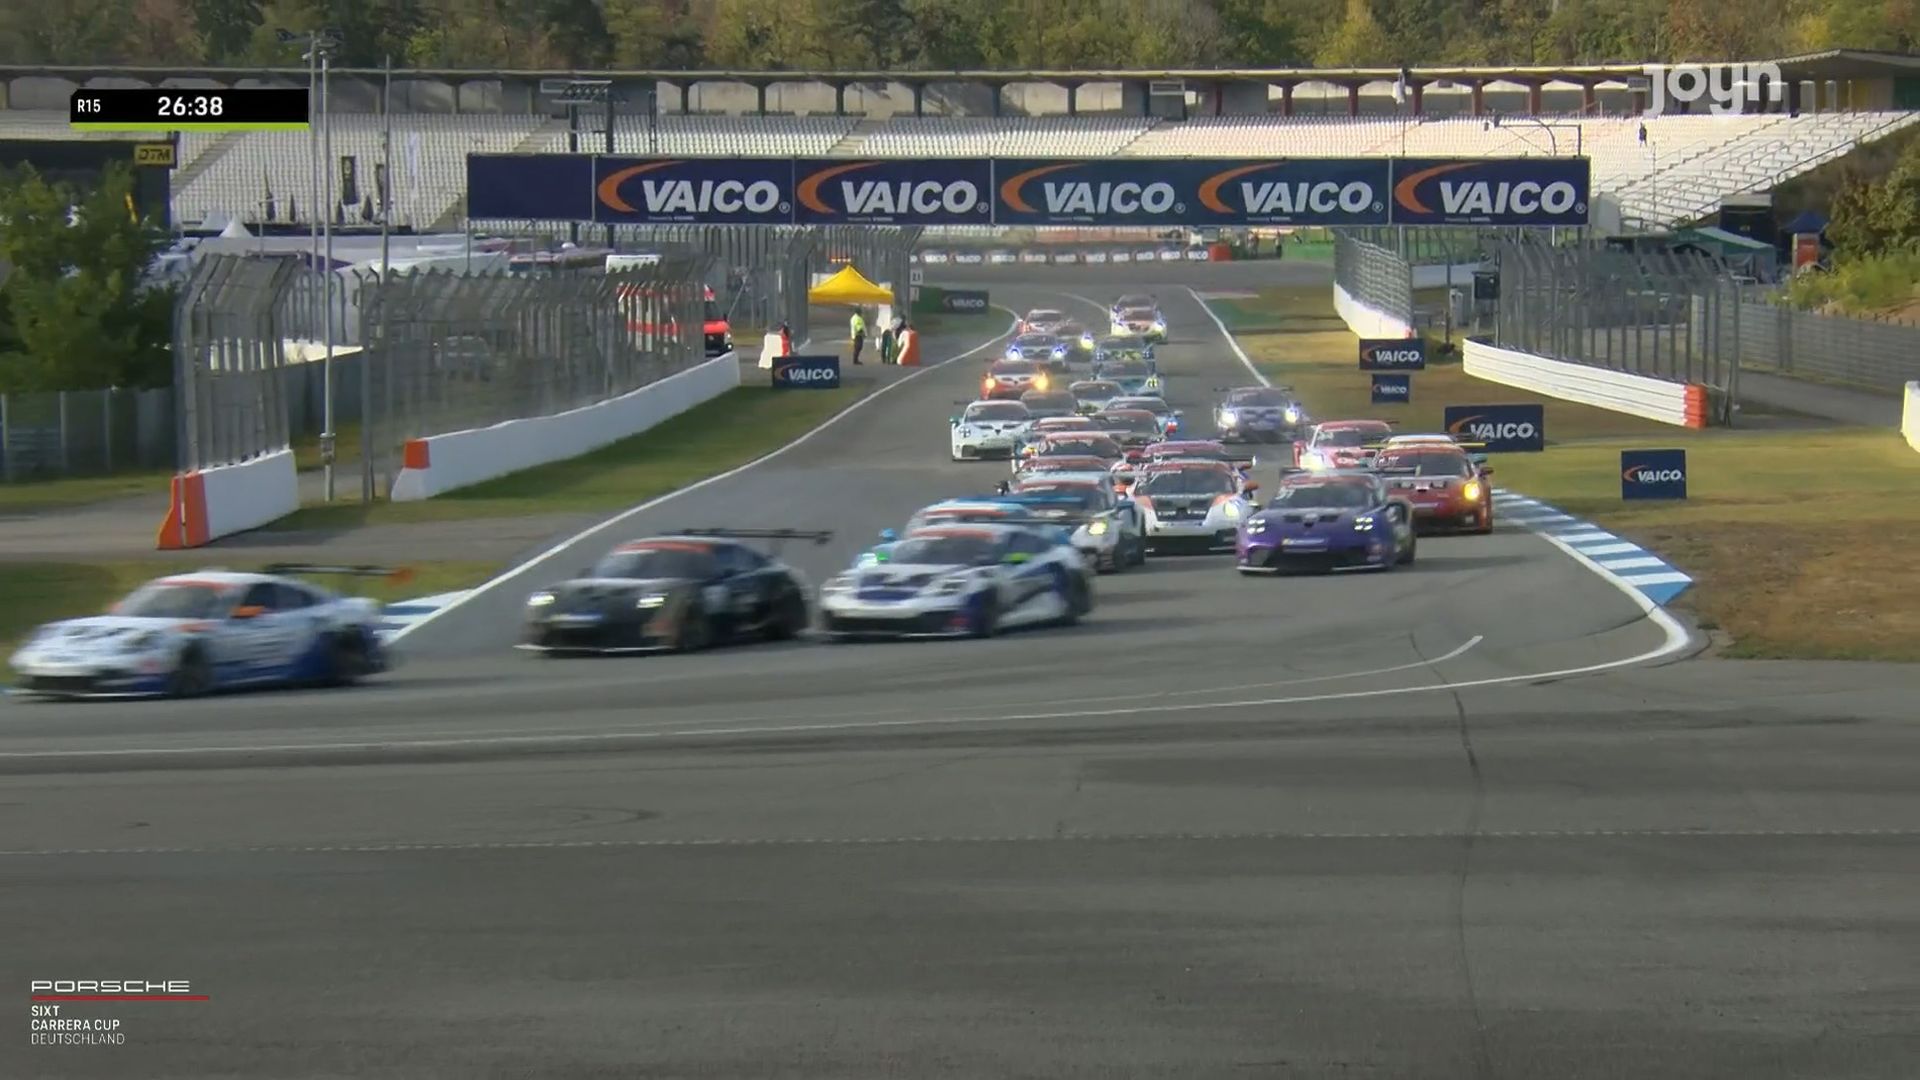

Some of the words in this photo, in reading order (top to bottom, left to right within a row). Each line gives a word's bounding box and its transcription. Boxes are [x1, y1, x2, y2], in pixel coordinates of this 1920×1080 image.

[138, 148, 171, 161] DTM
[1375, 350, 1419, 362] VAICO
[788, 368, 834, 380] VAICO
[1380, 386, 1407, 395] VAICO
[1470, 422, 1535, 439] VAICO
[1637, 469, 1683, 483] VAICO
